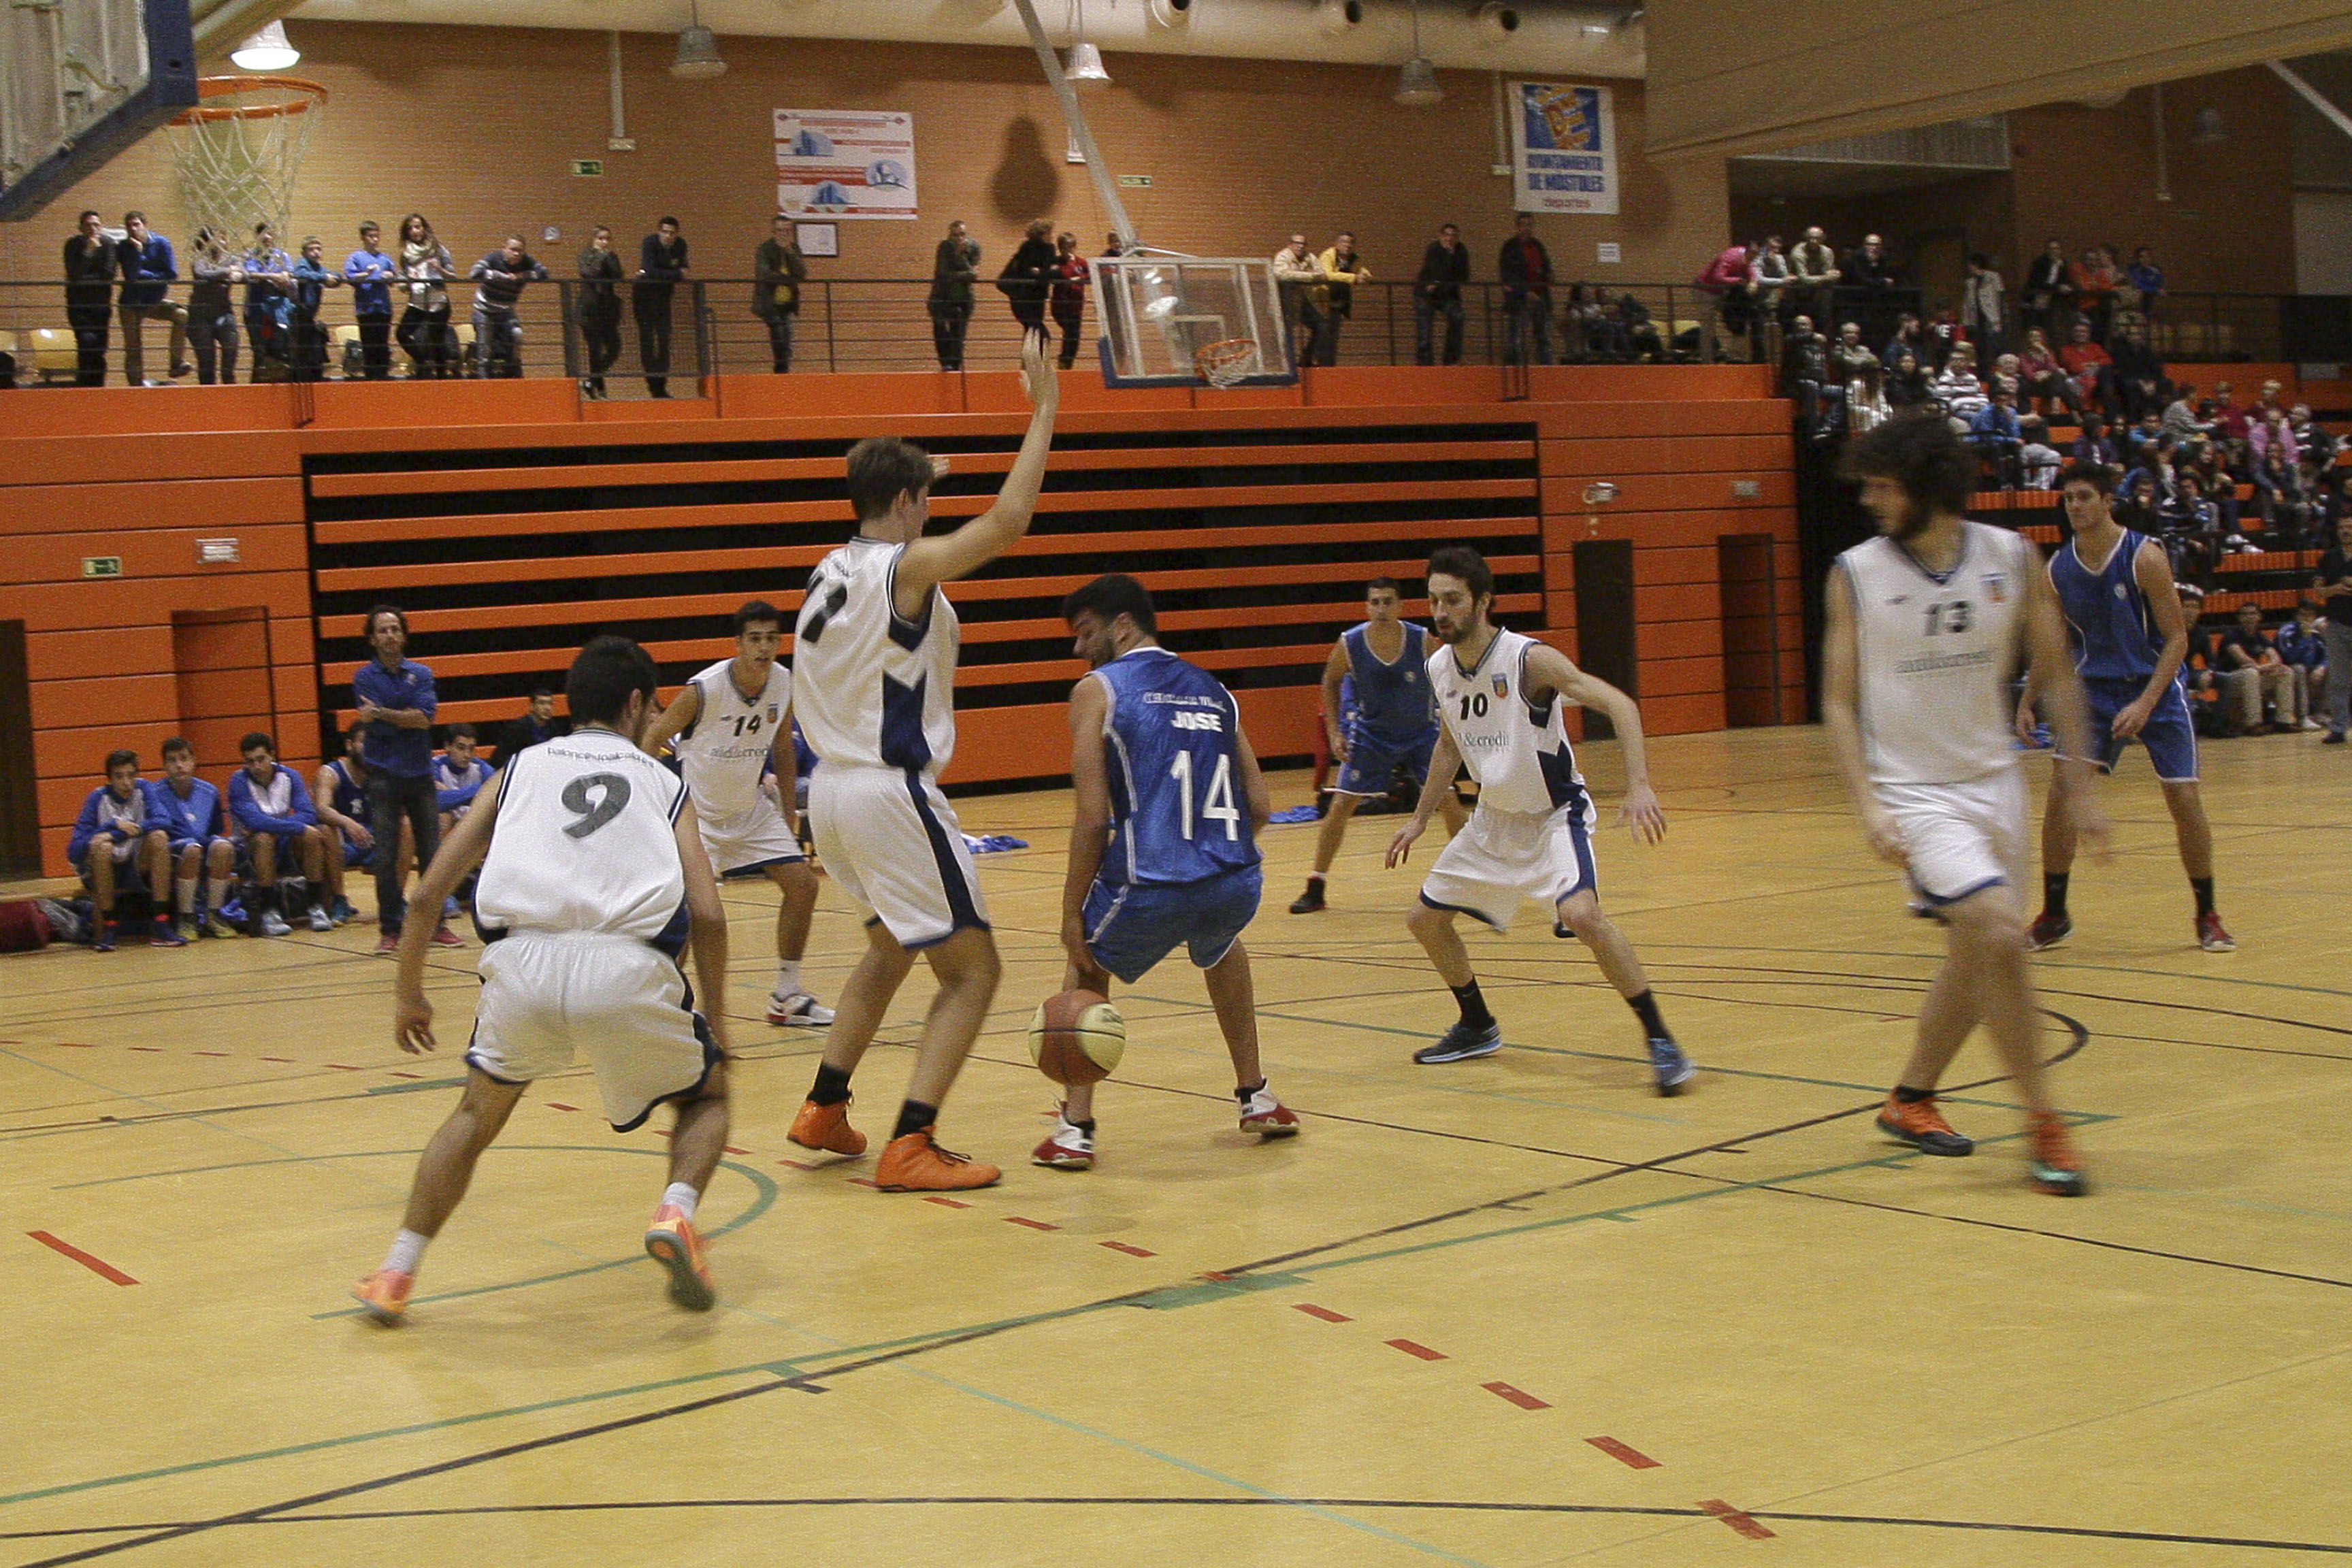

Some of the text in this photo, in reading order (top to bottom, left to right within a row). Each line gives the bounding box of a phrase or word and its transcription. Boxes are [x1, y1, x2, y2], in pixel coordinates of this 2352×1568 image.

[1460, 692, 1488, 720] 10
[734, 715, 762, 736] 14
[1171, 710, 1223, 732] JOSE
[561, 772, 632, 838] 9
[1170, 750, 1241, 841] 14
